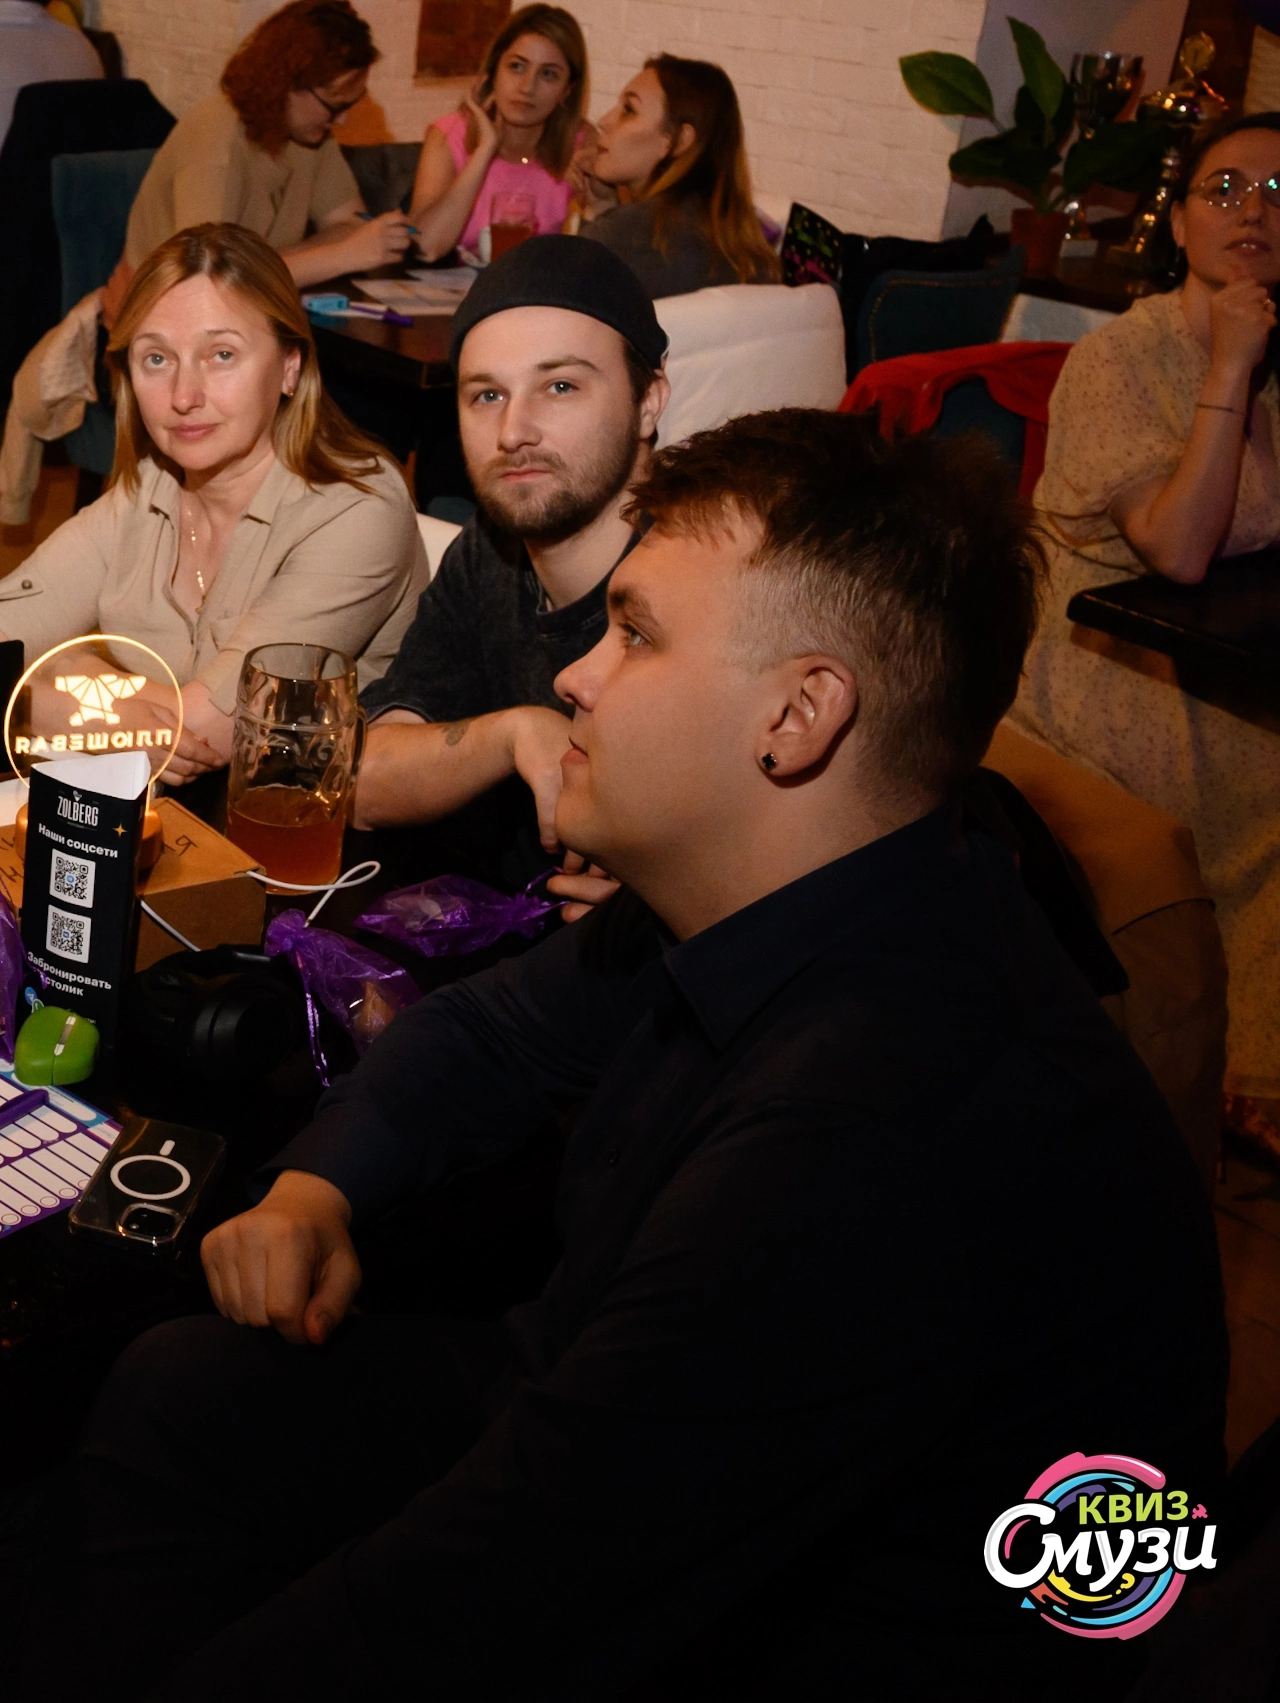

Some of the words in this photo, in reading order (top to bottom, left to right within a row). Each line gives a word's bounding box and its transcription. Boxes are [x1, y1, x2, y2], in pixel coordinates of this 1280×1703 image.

[57, 795, 99, 827] ZOLBERG
[38, 823, 65, 845] Наши
[66, 838, 119, 858] соцсети
[27, 951, 112, 990] Забронировать
[45, 976, 84, 996] столик
